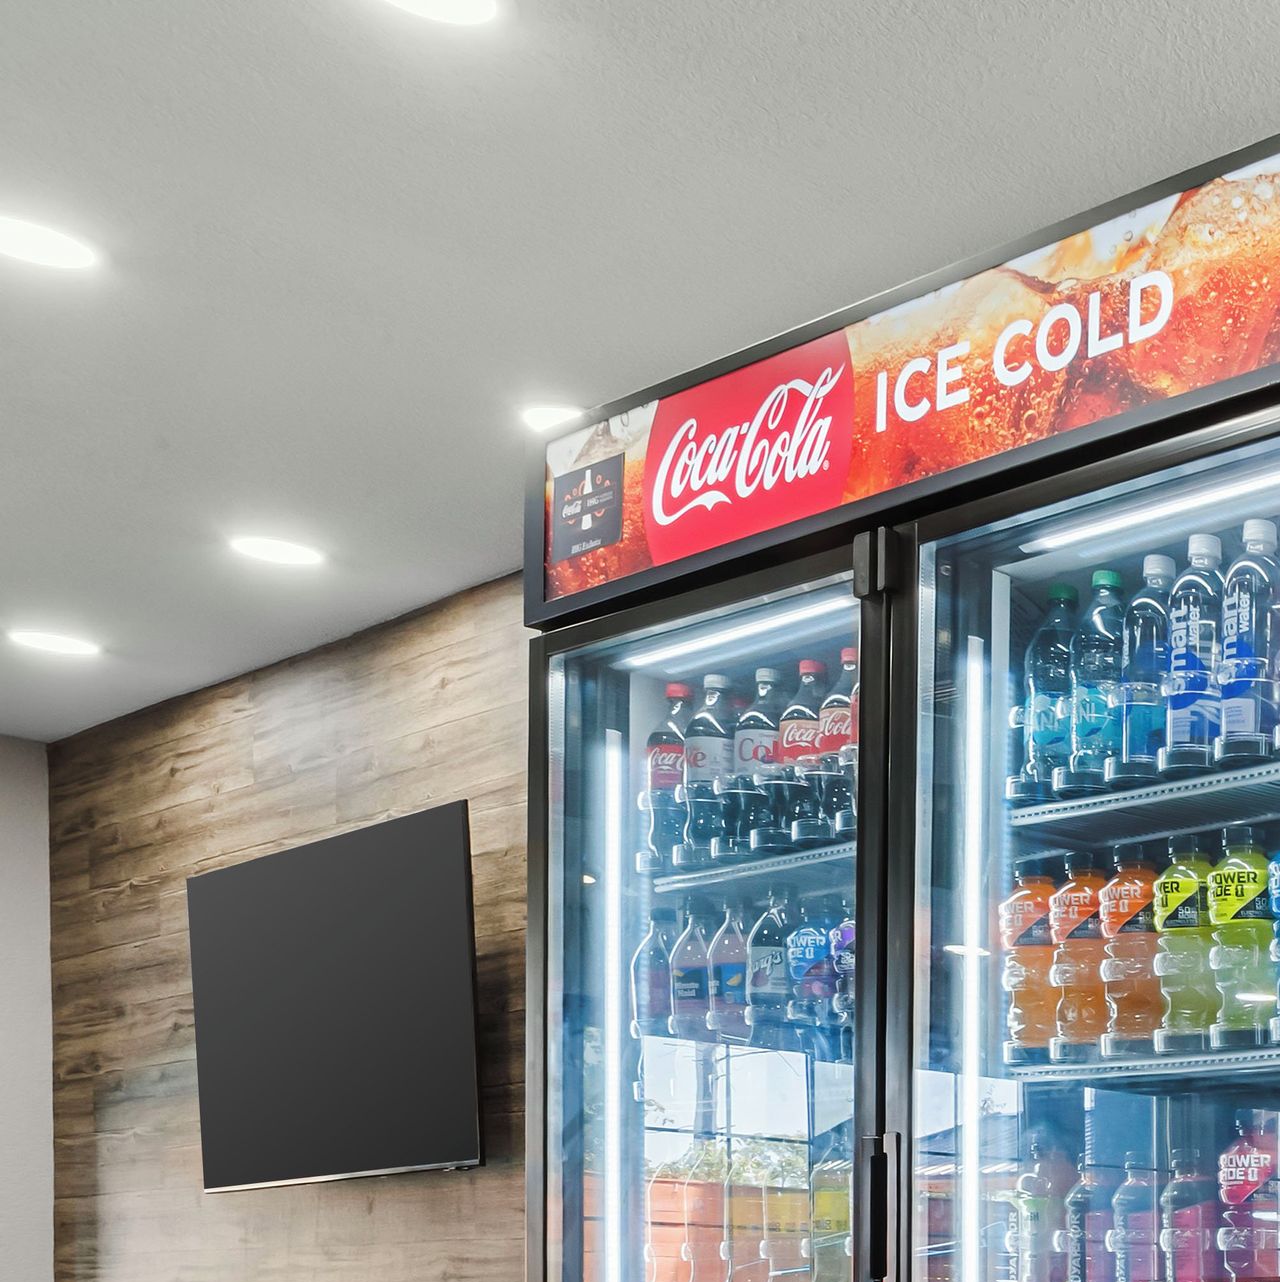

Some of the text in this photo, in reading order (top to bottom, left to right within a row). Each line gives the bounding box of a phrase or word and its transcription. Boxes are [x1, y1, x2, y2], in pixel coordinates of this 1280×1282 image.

[876, 270, 1175, 434] ICE COLD
[653, 362, 845, 527] Coca-Cola
